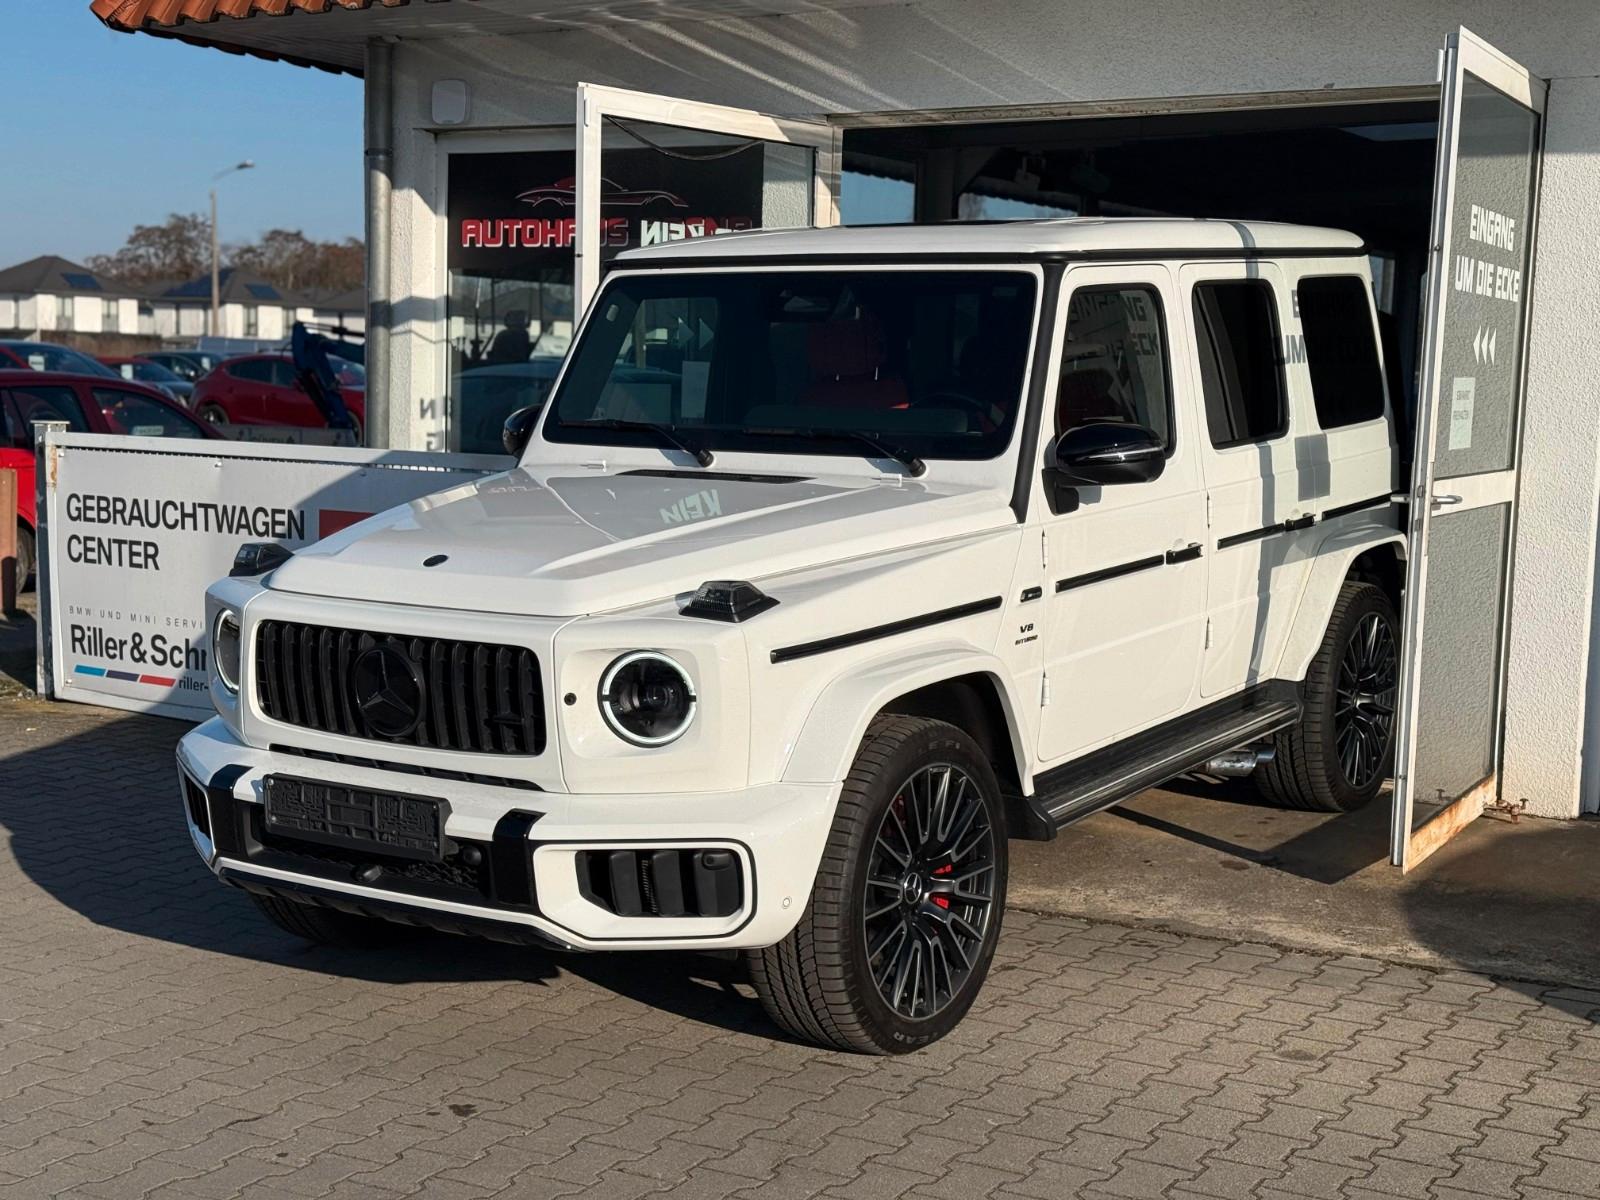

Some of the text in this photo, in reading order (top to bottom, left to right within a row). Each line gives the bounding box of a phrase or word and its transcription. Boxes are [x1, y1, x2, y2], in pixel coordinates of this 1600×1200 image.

[1469, 204, 1515, 251] EINGANG
[1455, 255, 1520, 302] UM DIE ECKE
[66, 493, 305, 541] GEBRAUCHTWAGEN
[66, 534, 160, 571] CENTER
[69, 605, 92, 617] BMW
[100, 610, 121, 621] UND
[130, 613, 157, 625] MINI
